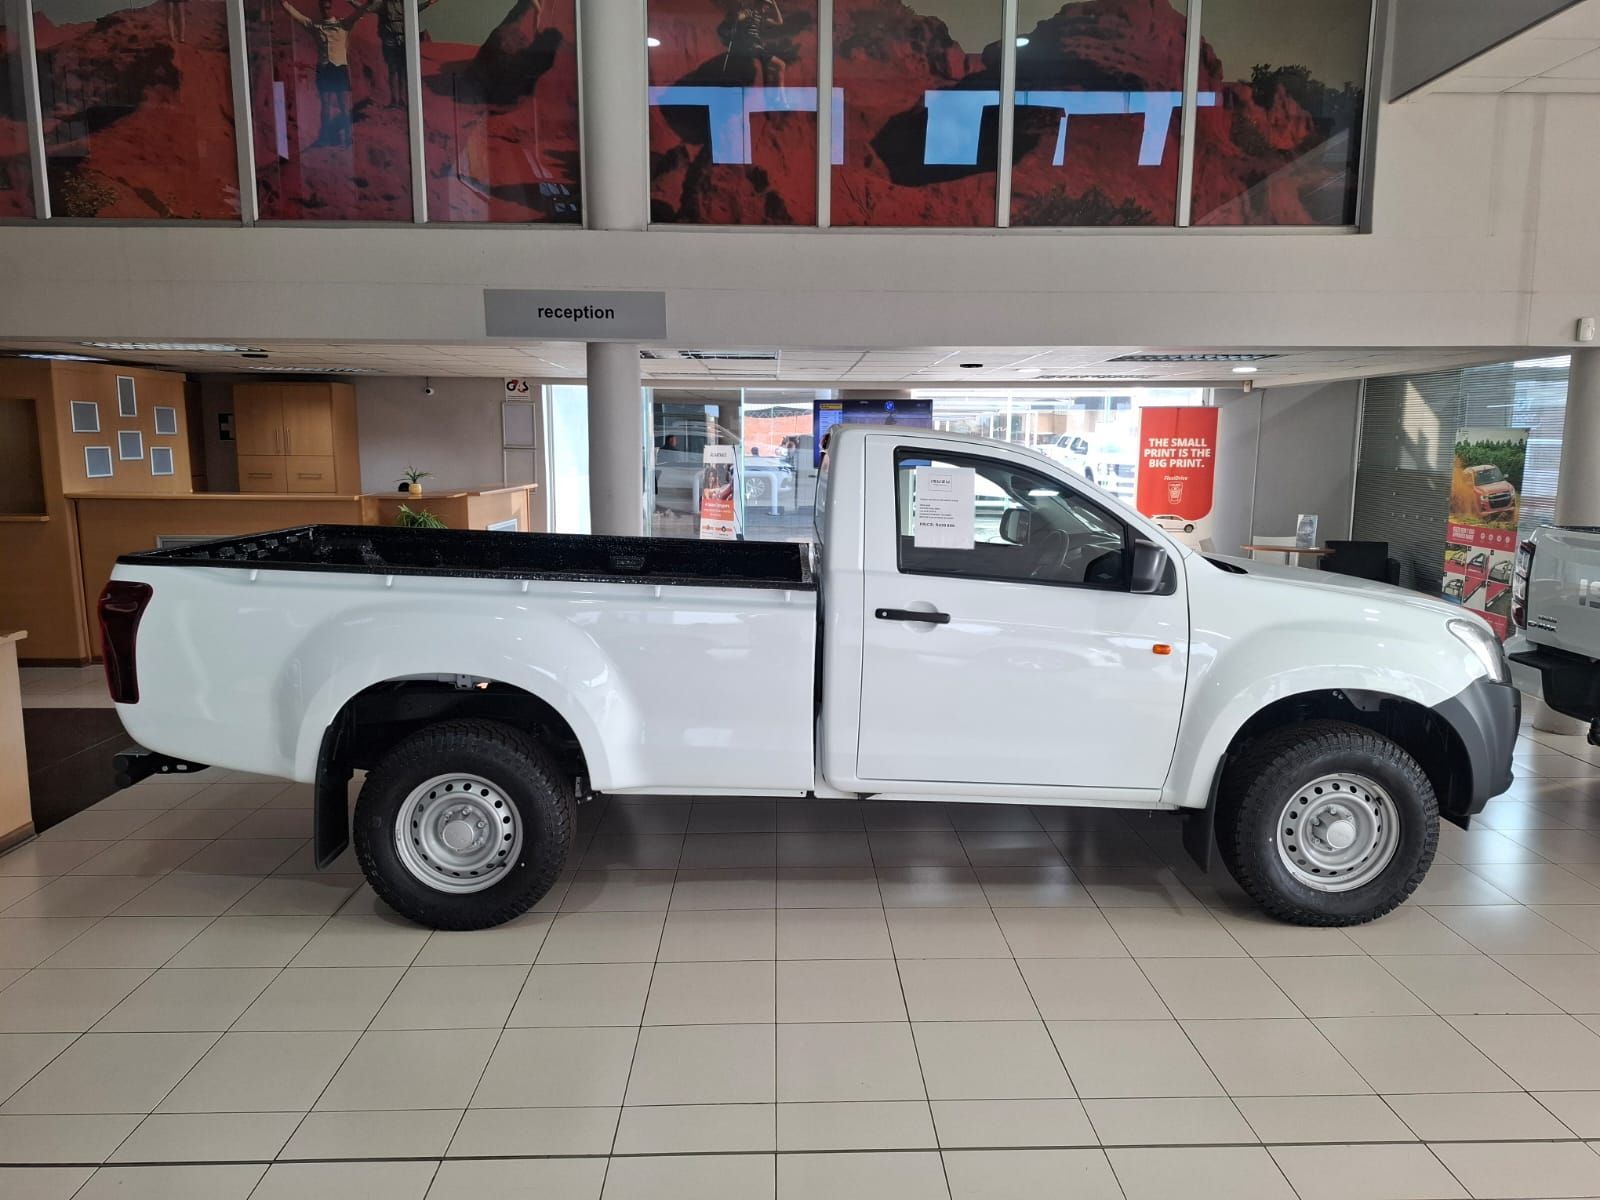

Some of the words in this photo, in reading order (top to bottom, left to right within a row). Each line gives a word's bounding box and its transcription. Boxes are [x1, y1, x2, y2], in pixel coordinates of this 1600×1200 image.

[537, 304, 615, 322] reception
[1148, 437, 1169, 447] THE
[1170, 438, 1207, 447] SMALL
[1143, 448, 1176, 458] PRINT
[1178, 448, 1188, 458] IS
[1191, 448, 1211, 457] THE
[1148, 458, 1167, 468] BIG
[1169, 458, 1205, 468] PRINT.
